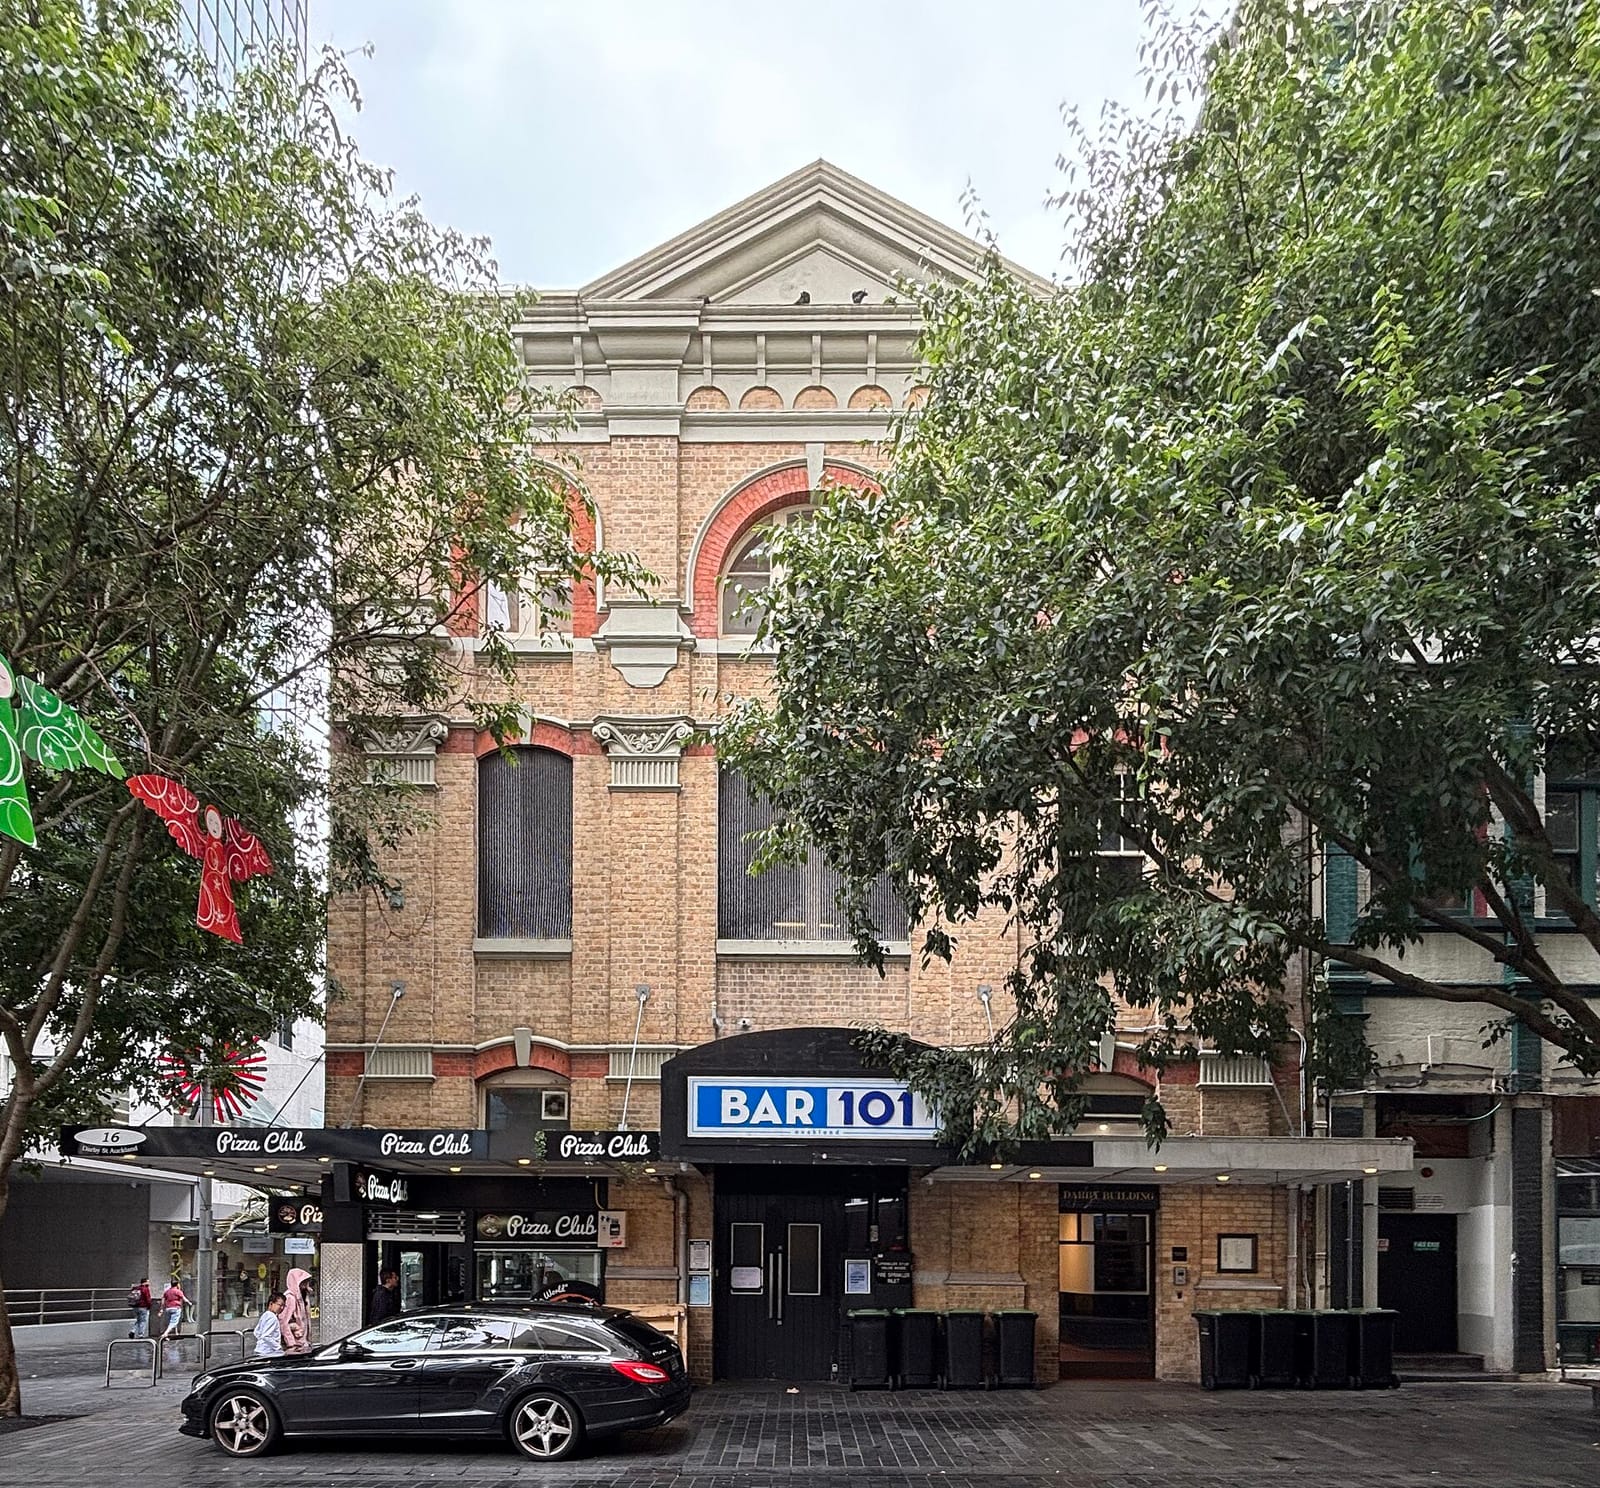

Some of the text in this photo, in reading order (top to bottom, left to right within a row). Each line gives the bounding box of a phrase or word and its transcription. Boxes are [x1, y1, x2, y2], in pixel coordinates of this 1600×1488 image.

[721, 1089, 913, 1126] BAR 101
[102, 1131, 120, 1143] 16
[216, 1130, 306, 1153] Pizza Club
[380, 1132, 472, 1156] Pizza Club
[560, 1134, 651, 1158] Pizza Club
[367, 1174, 390, 1200] Pizza
[1102, 1191, 1154, 1201] BUILDING
[300, 1204, 325, 1225] Piz
[507, 1214, 551, 1237] Pizza
[555, 1214, 597, 1237] Club
